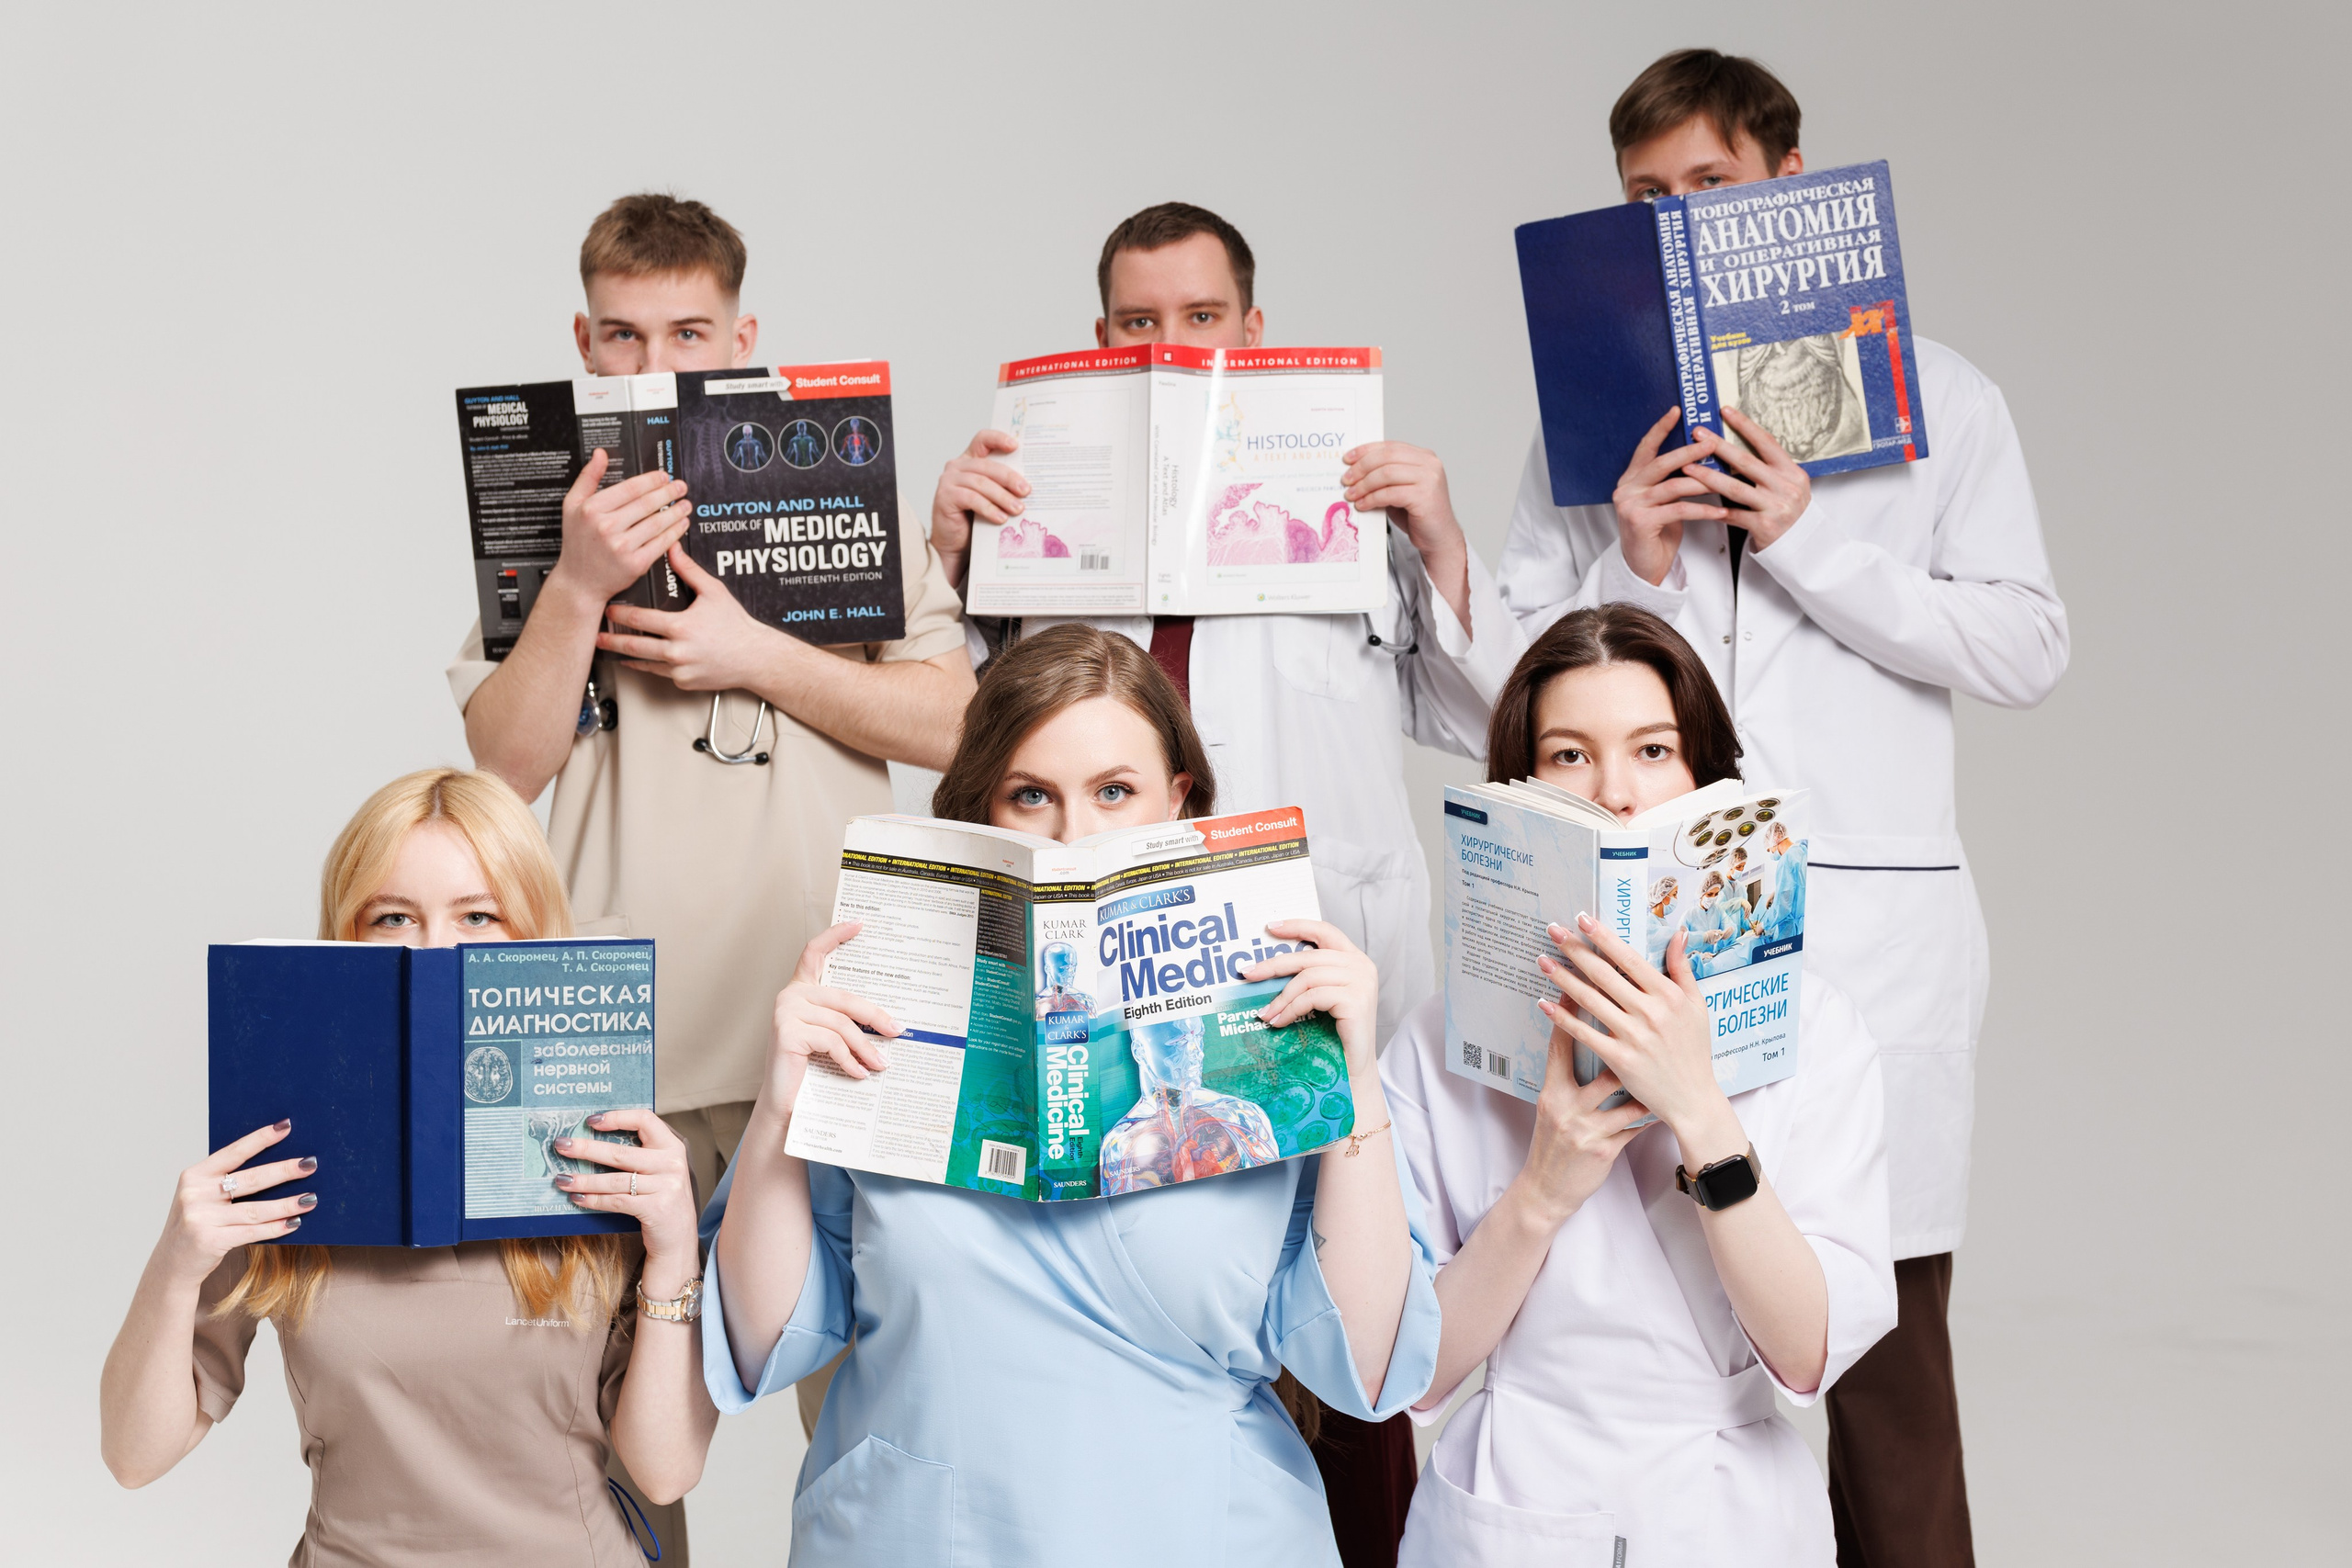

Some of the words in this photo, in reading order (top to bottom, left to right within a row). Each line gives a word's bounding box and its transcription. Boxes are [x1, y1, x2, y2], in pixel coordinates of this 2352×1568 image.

[1690, 177, 1875, 221] ТОПОГРАФИЧЕСКАЯ
[1696, 193, 1880, 256] АНАТОМИЯ
[1658, 211, 1679, 288] АНАТОМИЯ
[1671, 209, 1692, 288] ХИРУРГИЯ
[1699, 258, 1715, 273] И
[1724, 229, 1883, 269] ОПЕРАТИВНАЯ
[1700, 244, 1887, 308] ХИРУРГИЯ
[1779, 300, 1790, 315] 2
[1792, 301, 1815, 312] том
[1710, 332, 1747, 343] Учебник
[1669, 292, 1699, 426] ТОПОГРАФИЧЕСКАЯ
[1683, 296, 1709, 405] ОПЕРАТИВНАЯ
[1015, 361, 1090, 377] INTERNATIONAL
[1095, 356, 1136, 367] EDITION
[1202, 357, 1299, 367] INERNATIONAL
[1306, 356, 1358, 365] EDITION
[726, 382, 744, 390] Study
[796, 377, 837, 389] Student
[839, 374, 880, 386] Consult
[487, 401, 528, 415] MEDICAL
[472, 413, 528, 428] PHYSIOLOGY
[647, 416, 670, 424] HALL
[1699, 412, 1712, 423] И
[1248, 433, 1345, 450] HISTOLOGY
[1264, 453, 1286, 461] TEXT
[1170, 464, 1179, 509] Histology
[696, 502, 771, 517] GUYTON
[776, 499, 815, 513] AND
[820, 496, 865, 510] HALL
[698, 520, 748, 534] TEXTBOOK
[750, 519, 762, 530] OF
[763, 512, 887, 544] MEDICAL
[717, 541, 887, 576] PHYSIOLOGY
[779, 574, 840, 586] THIRTEENTH
[842, 572, 882, 582] EDITION
[782, 609, 825, 622] JOHN
[829, 608, 842, 619] E.
[847, 606, 885, 617] HALL
[1461, 809, 1480, 819] УЧЕБНИК
[1146, 840, 1163, 850] Study
[1165, 837, 1184, 847] smart
[1184, 834, 1199, 843] with
[1211, 823, 1252, 840] Student
[1255, 818, 1297, 832] Consult
[1174, 855, 1212, 868] INTERNATIONAL
[1213, 852, 1233, 862] EDITION
[1238, 844, 1278, 857] INTERNATIONAL
[1279, 841, 1299, 850] EDITION
[1461, 834, 1533, 866] ХИРУРГИЧЕСКИЕ
[868, 855, 888, 863] EDITION
[892, 859, 928, 869] INTERNATIONAL
[929, 863, 946, 872] EDITION
[1216, 861, 1235, 869] Australia,
[1254, 855, 1270, 863] Europe,
[1461, 849, 1502, 872] БОЛЕЗНИ
[1470, 871, 1489, 882] редакцией
[1490, 877, 1513, 889] профессора
[1522, 888, 1539, 897] Крылова
[1100, 904, 1128, 921] KUMAR
[1139, 889, 1191, 909] CLARK'S
[1043, 919, 1087, 930] KUMAR
[1046, 930, 1084, 940] CLARK
[1100, 902, 1239, 966] Clinical
[469, 953, 480, 963] А.
[483, 953, 494, 963] А.
[498, 953, 559, 964] Скоромец,
[562, 952, 573, 960] А.
[577, 951, 588, 960] П.
[592, 950, 651, 963] Скоромец,
[1764, 942, 1792, 957] УЧЕБНИК
[562, 964, 572, 973] Т.
[576, 964, 587, 972] А.
[590, 962, 649, 974] Скоромец
[469, 985, 650, 1008] ТОПИЧЕСКАЯ
[1705, 973, 1789, 1011] РГИЧЕСКИЕ
[1124, 1000, 1162, 1021] Eighth
[1165, 993, 1212, 1011] Edition
[1215, 1003, 1238, 1011] EDITED
[469, 1011, 652, 1035] ДИАГНОСТИКА
[1048, 1015, 1085, 1025] KUMAR
[1718, 998, 1787, 1037] БОЛЕЗНИ
[1047, 1030, 1086, 1041] CLARK'S
[534, 1040, 652, 1057] заболеваний
[1713, 1044, 1747, 1060] профессора
[1762, 1033, 1786, 1047] Крылова
[1762, 1050, 1778, 1061] Том
[1781, 1047, 1785, 1055] 1
[534, 1060, 610, 1078] нервной
[534, 1082, 612, 1095] системы
[1068, 1045, 1090, 1135] Clinical
[1046, 1046, 1069, 1160] Medicine
[804, 1127, 837, 1138] SAUNDERS
[1076, 1137, 1084, 1159] Eighth
[1110, 1166, 1140, 1177] SAUNDERS
[1054, 1180, 1087, 1189] SAUNDERS
